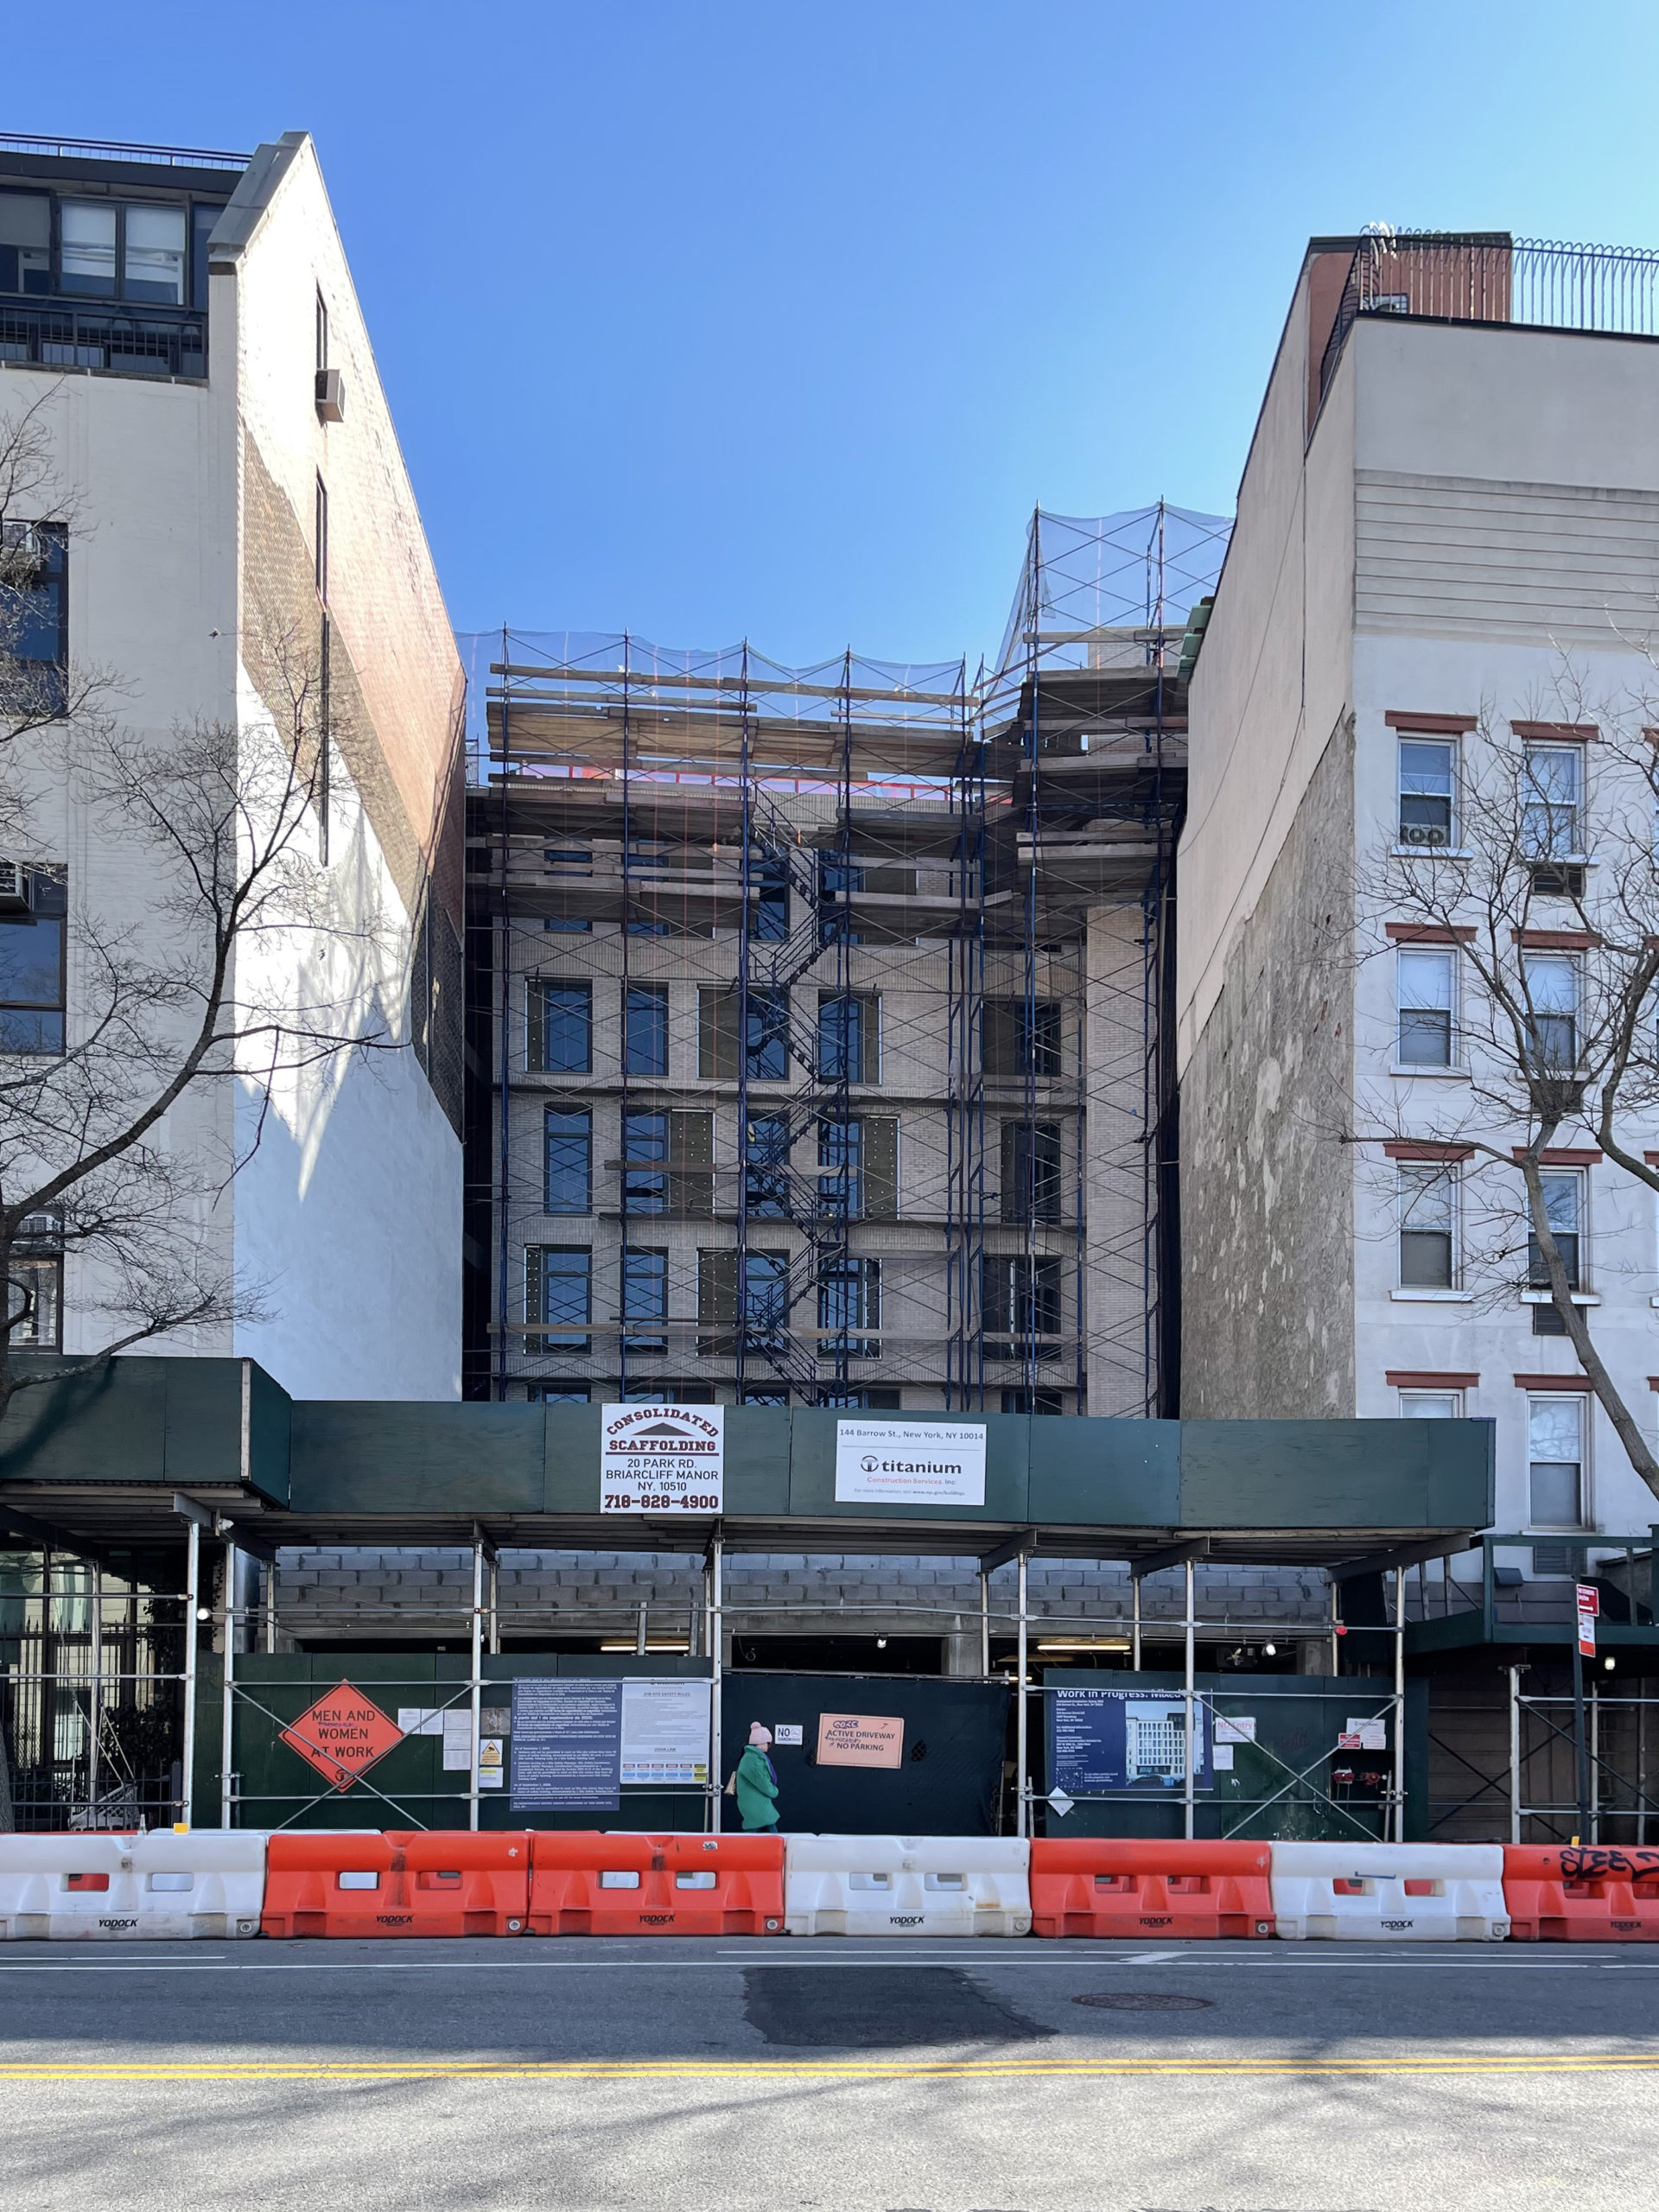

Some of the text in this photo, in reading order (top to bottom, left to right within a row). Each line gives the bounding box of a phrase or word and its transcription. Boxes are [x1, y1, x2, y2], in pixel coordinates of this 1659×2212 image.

[607, 1408, 719, 1438] CONSOLIDATED
[924, 1431, 944, 1440] York,
[609, 1440, 716, 1452] SCAFFOLDING
[627, 1459, 697, 1468] 20 PARK RD.
[881, 1459, 962, 1474] titanium
[606, 1470, 719, 1480] BRIARCLIFF MANOR
[660, 1482, 687, 1491] 10510
[605, 1495, 719, 1509] 718-828-4900
[312, 1710, 375, 1721] MEN AND
[318, 1728, 368, 1739] WOMEN
[778, 1727, 791, 1737] NO
[856, 1731, 895, 1739] DRIVEWAY
[850, 1743, 884, 1751] PARKING
[311, 1746, 374, 1758] AT WORK
[99, 1918, 138, 1927] YODOCK
[376, 1914, 414, 1923] YODOCK
[639, 1914, 676, 1923] YODOCK
[889, 1915, 925, 1924] YODOCK
[1380, 1919, 1414, 1928] YODOCK
